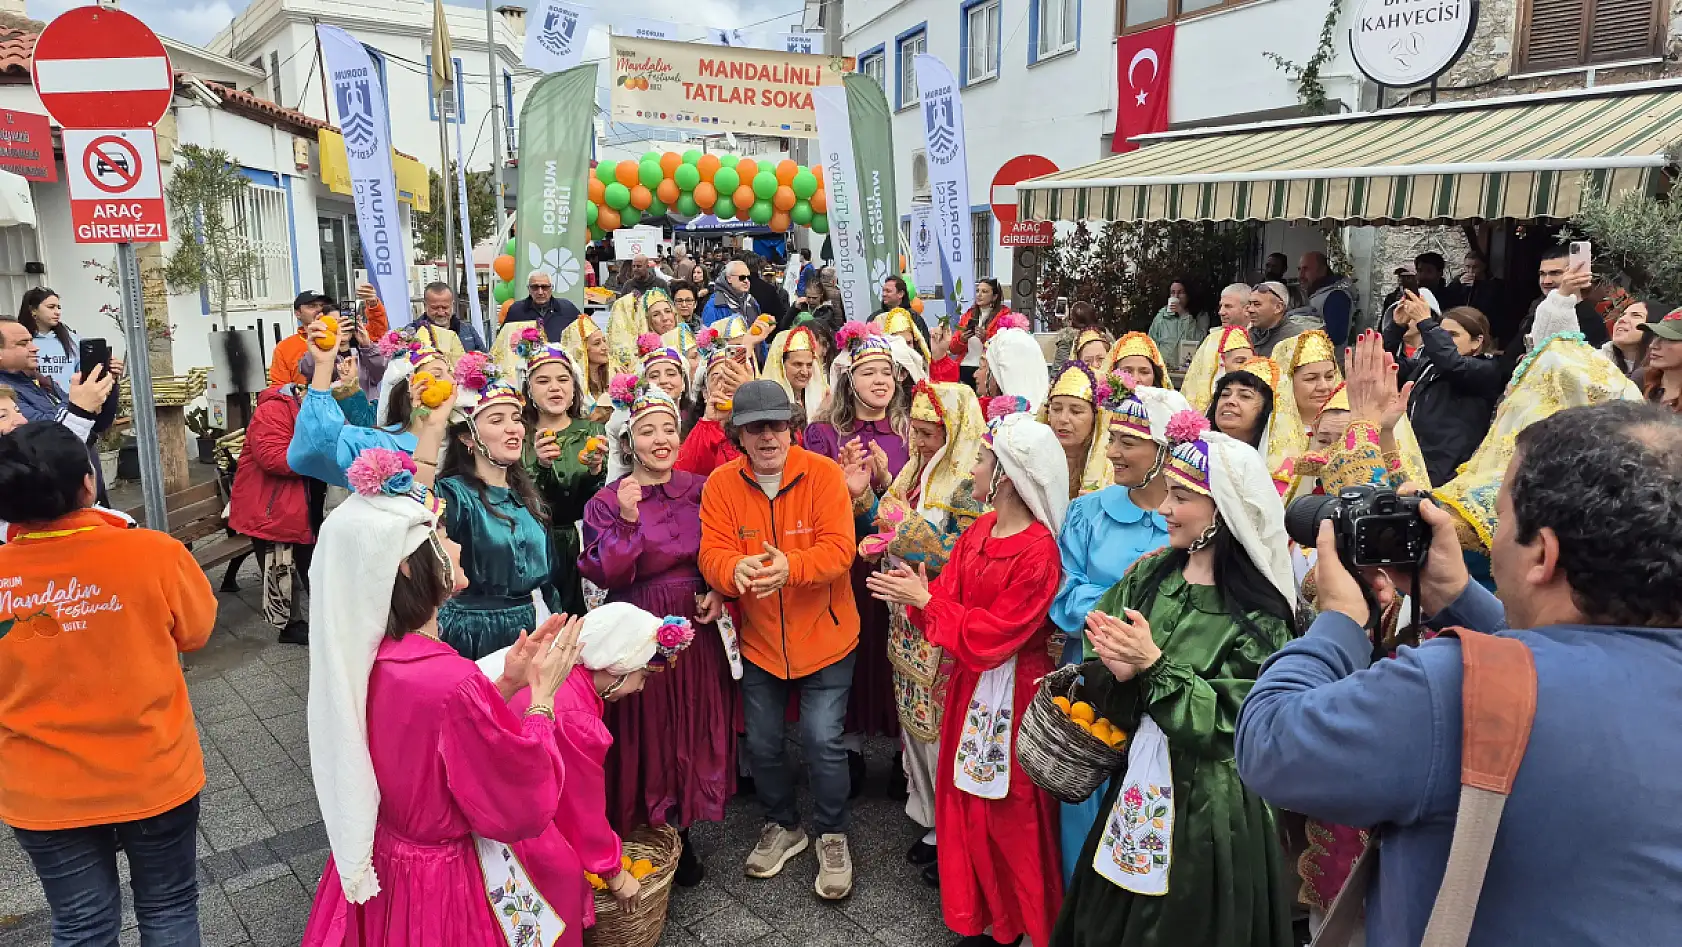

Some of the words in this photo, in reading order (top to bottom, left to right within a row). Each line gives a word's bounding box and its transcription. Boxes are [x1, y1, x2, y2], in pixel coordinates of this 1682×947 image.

[1361, 0, 1460, 32] KAHVECİSİ
[699, 58, 821, 86] MANDALİNLİ
[682, 82, 757, 106] TATLAR
[760, 89, 815, 111] SOKA
[543, 160, 557, 234] BODRUM
[93, 203, 143, 221] ARAÇ
[556, 185, 571, 235] YEŞİLİ
[78, 222, 162, 239] GİREMEZ!
[1002, 234, 1049, 244] GİREMEZ!
[1012, 223, 1040, 234] ARAÇ
[37, 365, 64, 374] NERGY
[52, 594, 123, 618] Festivali
